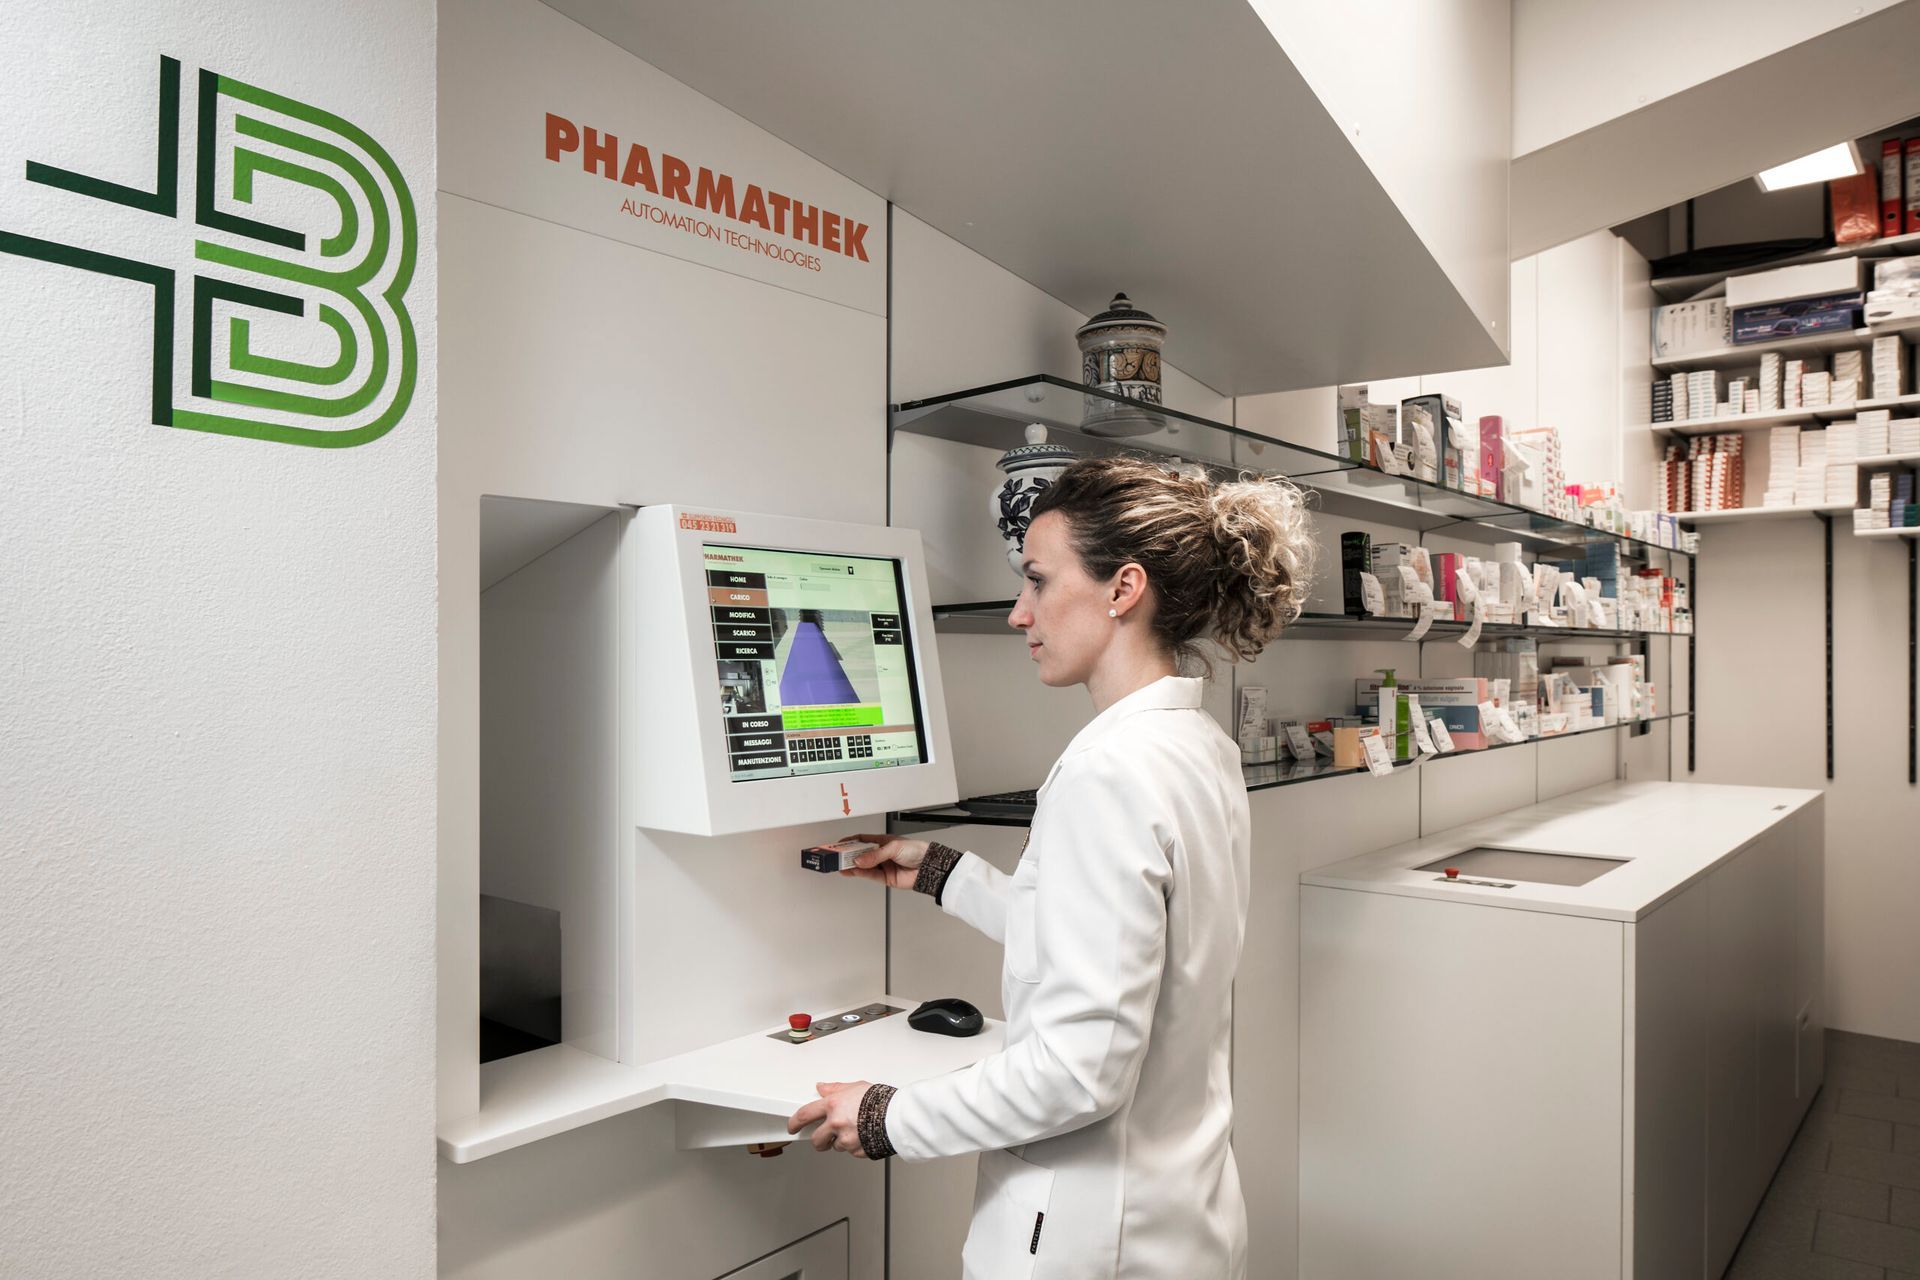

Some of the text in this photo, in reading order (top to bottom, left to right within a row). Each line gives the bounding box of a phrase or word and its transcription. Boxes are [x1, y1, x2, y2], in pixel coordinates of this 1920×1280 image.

[546, 112, 870, 263] PHARMATHEK
[620, 197, 822, 272] AUTOMATION TECHNOLOGIES
[681, 519, 698, 530] 045
[730, 575, 747, 583] HOME
[730, 593, 750, 601] CARICO
[729, 611, 756, 619] MODIFICA
[732, 629, 757, 637] SCARICO
[750, 720, 769, 728] CORSO
[743, 738, 772, 747] MESSAGGI
[738, 756, 782, 766] MANUTENZIONE
